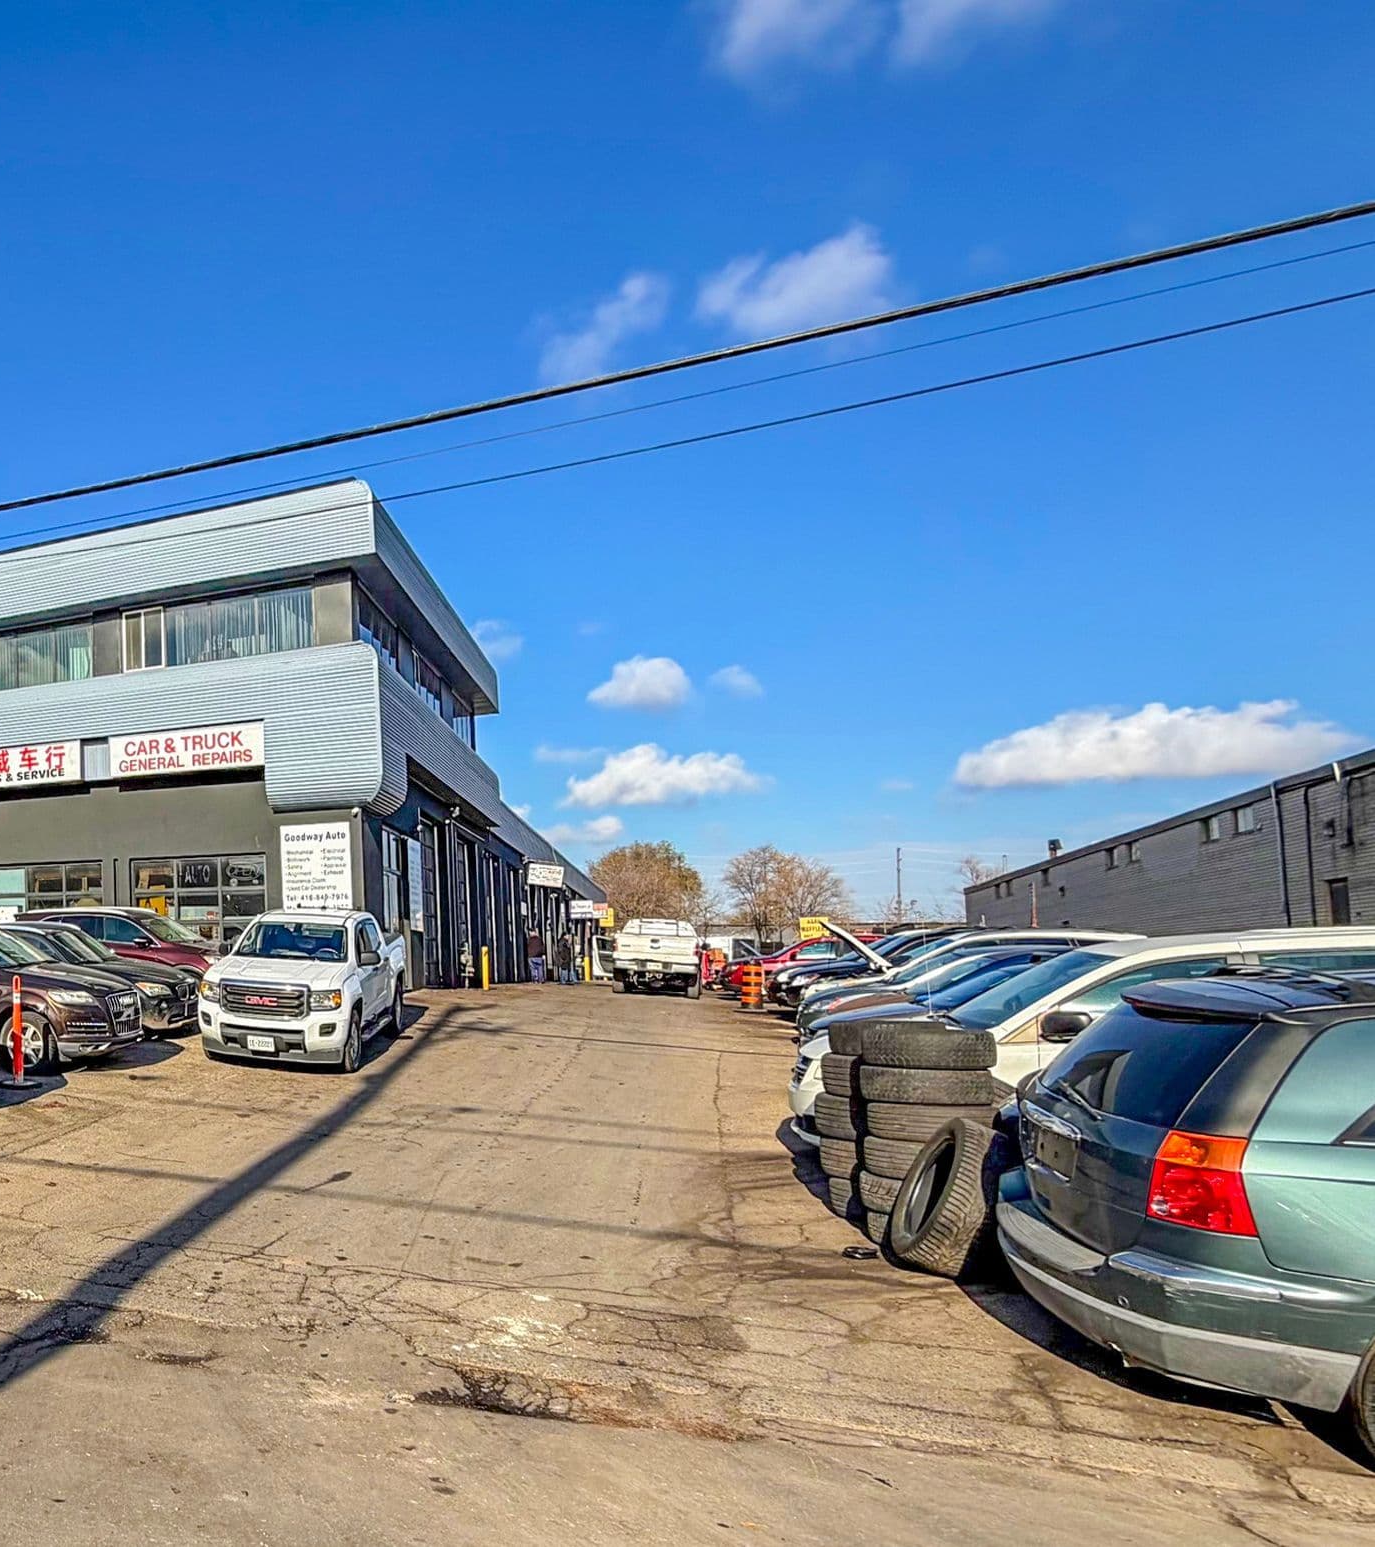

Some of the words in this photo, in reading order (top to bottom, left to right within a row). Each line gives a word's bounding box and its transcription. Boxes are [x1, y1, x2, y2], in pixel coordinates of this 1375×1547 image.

[124, 739, 160, 757] CAR
[164, 737, 176, 753] &
[180, 730, 244, 752] TRUCK
[118, 755, 185, 773] GENERAL
[192, 749, 253, 766] REPAIRS
[5, 773, 14, 782] &
[16, 768, 65, 781] SERVICE
[284, 832, 323, 842] Goodway
[325, 831, 346, 840] Auto
[184, 864, 210, 884] AUTO
[245, 995, 278, 1006] GMC
